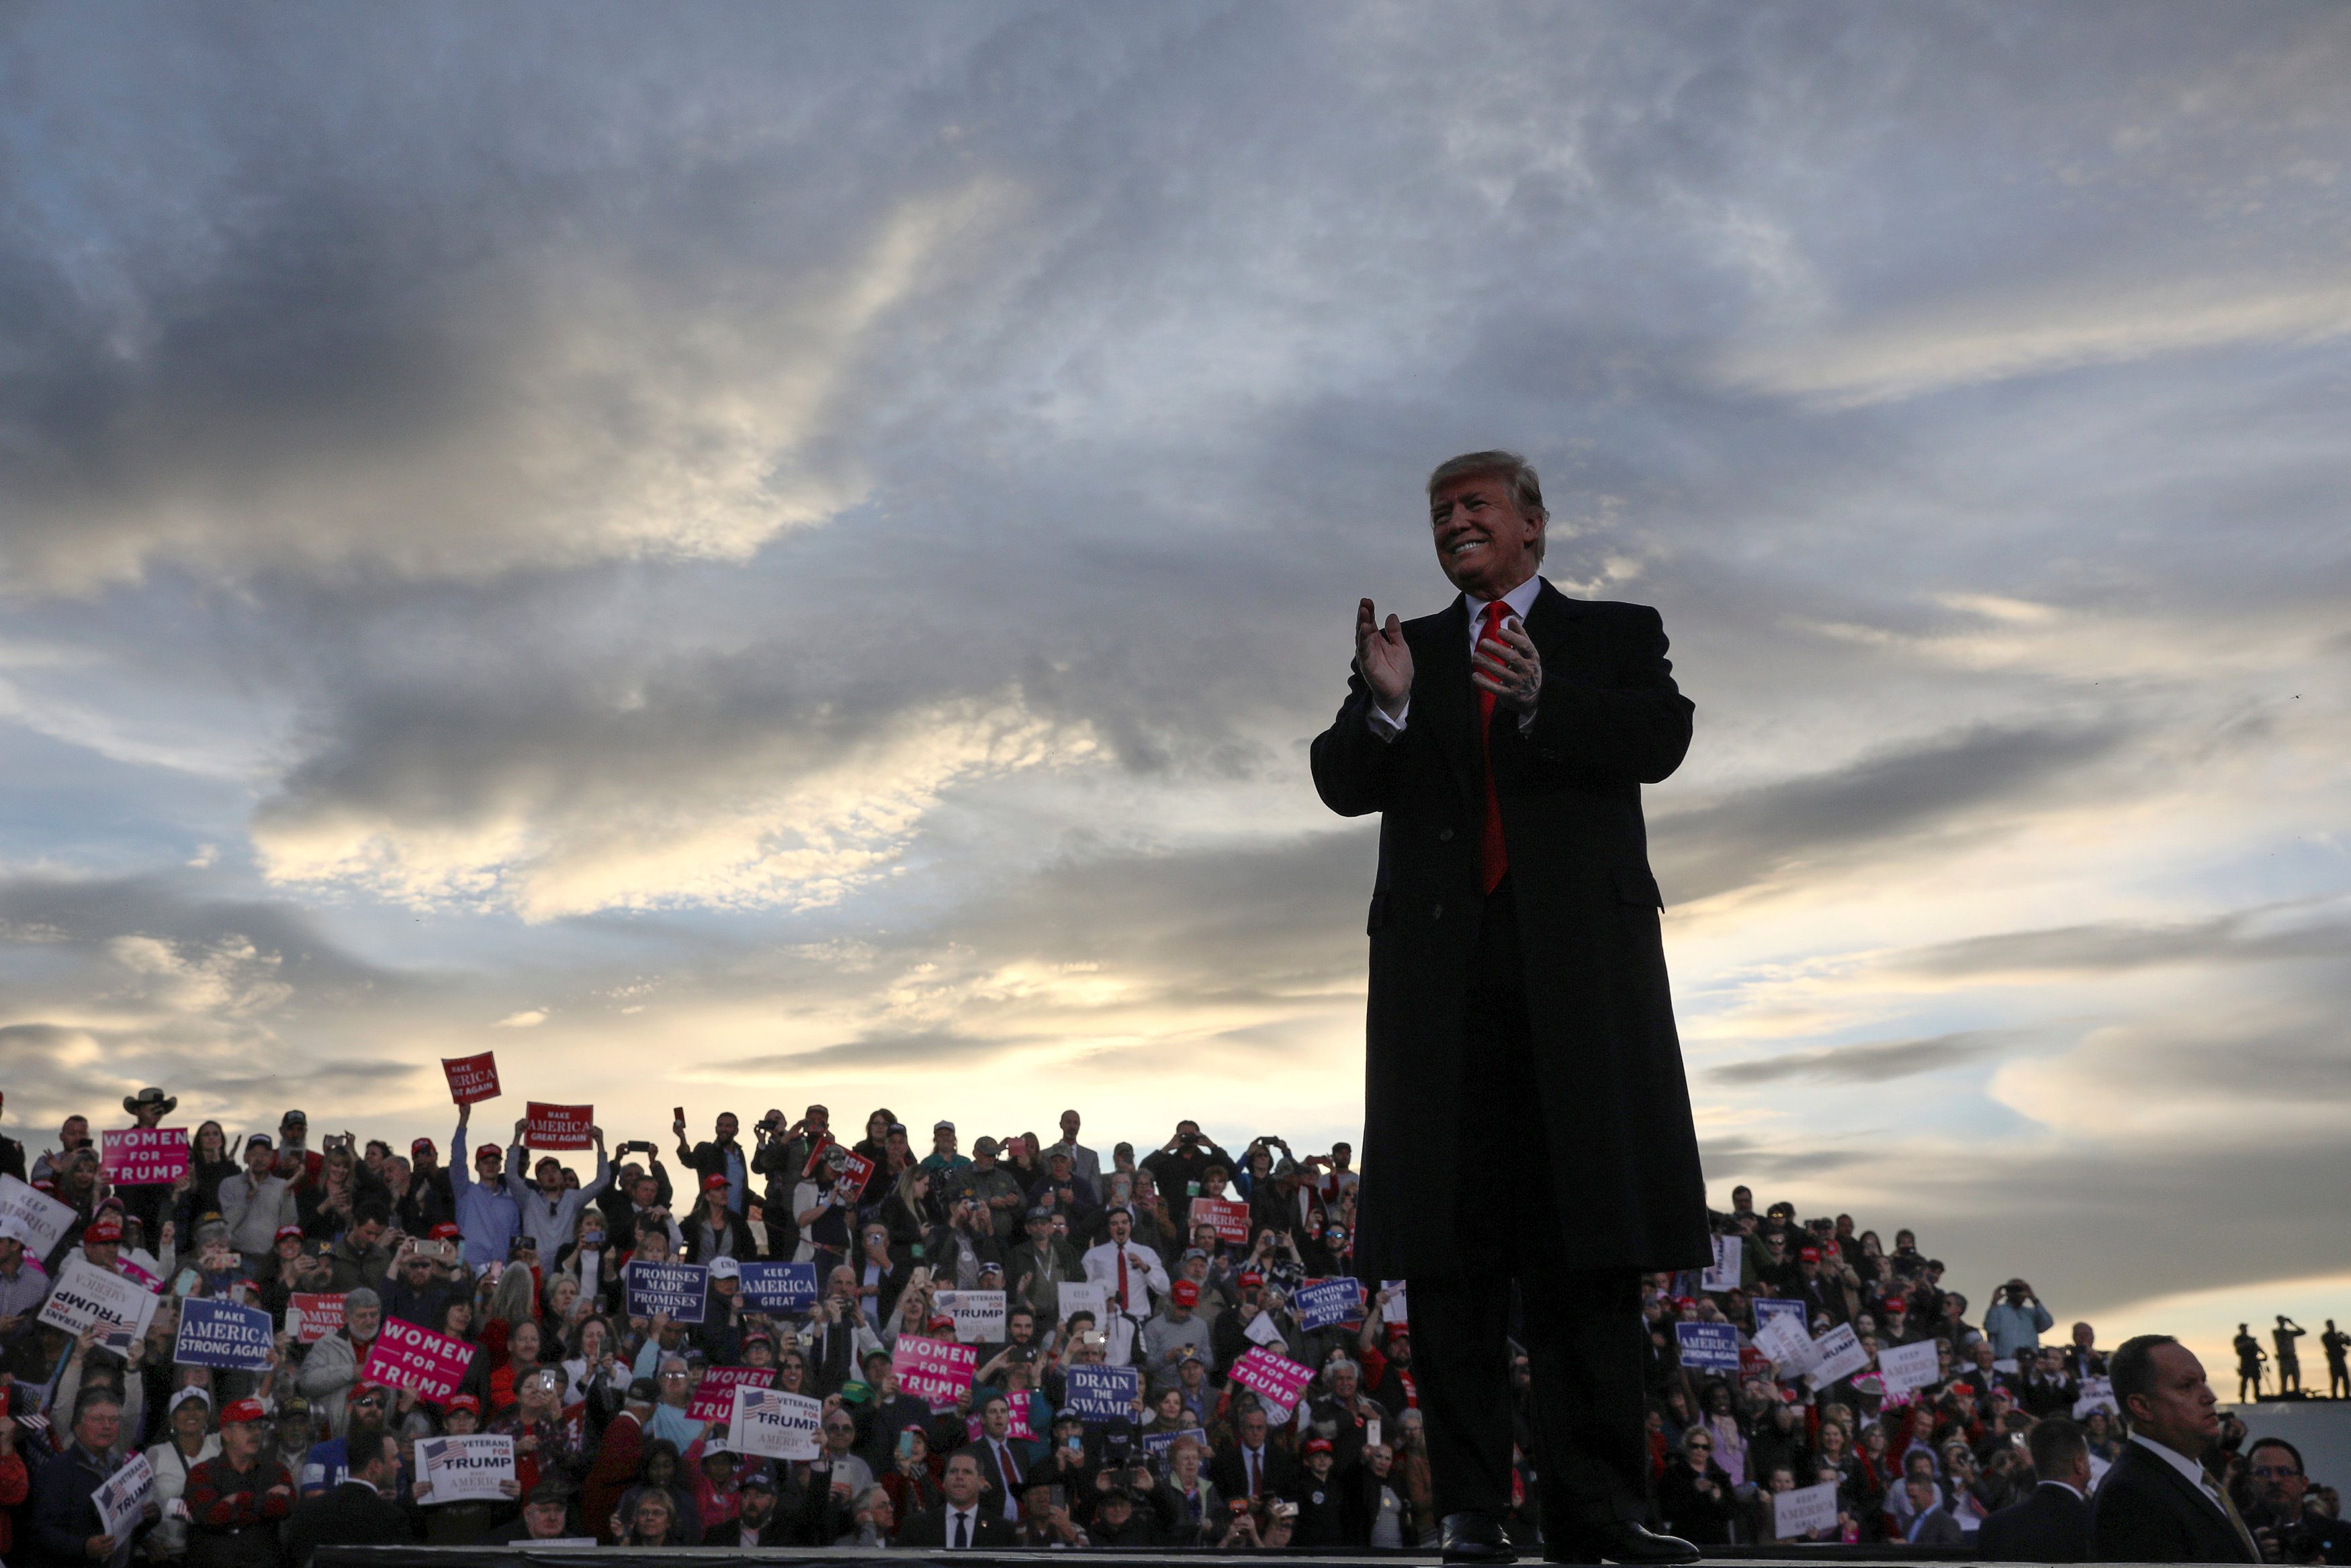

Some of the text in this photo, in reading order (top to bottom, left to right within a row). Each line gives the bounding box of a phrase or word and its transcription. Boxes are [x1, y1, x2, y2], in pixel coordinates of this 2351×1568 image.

[451, 1068, 494, 1086] ERICA
[465, 1082, 493, 1095] AGAIN
[547, 1111, 570, 1119] MAKE
[528, 1119, 590, 1132] AMERICA
[104, 1131, 187, 1147] WOMEN
[531, 1134, 586, 1142] GREAT AGAIN
[129, 1150, 160, 1162] FOR
[105, 1165, 183, 1180] TRUMP
[1197, 1213, 1240, 1227] MERIC
[635, 1267, 699, 1283] PROMISES
[763, 1268, 791, 1277] KEEP
[647, 1279, 684, 1292] MADE
[743, 1279, 815, 1293] AMERICA
[1302, 1282, 1353, 1302] PROMISES
[634, 1292, 697, 1307] PROMISES
[761, 1296, 795, 1307] GREAT
[1313, 1291, 1342, 1304] MADE
[55, 1292, 122, 1326] TRUMP
[214, 1309, 245, 1323] MAKE
[646, 1304, 679, 1317] KEPT
[952, 1309, 1004, 1318] TRUMP
[1305, 1301, 1356, 1318] PROMISES
[1318, 1311, 1345, 1322] KEPT
[44, 1308, 87, 1330] ETERANS
[300, 1310, 345, 1324] AMER
[181, 1320, 271, 1346] AMERICA
[1698, 1328, 1719, 1336] MAKE
[179, 1338, 230, 1355] STRONG
[384, 1320, 474, 1365] WOMEN
[1681, 1337, 1737, 1351] AMERICA
[1823, 1338, 1855, 1360] RUMP
[900, 1338, 976, 1365] WOMEN
[402, 1351, 436, 1373] FOR
[919, 1361, 948, 1375] FOR
[1251, 1347, 1315, 1381] WOMEN
[371, 1359, 451, 1398] TRUMP
[705, 1369, 774, 1387] WOMEN
[1259, 1365, 1284, 1380] FOR
[895, 1372, 966, 1397] TRUMP
[1075, 1373, 1129, 1390] DRAIN
[1237, 1365, 1294, 1401] TRUMP
[718, 1388, 734, 1399] FO
[1093, 1388, 1113, 1399] THE
[693, 1401, 729, 1418] TRU
[777, 1396, 819, 1412] VETERANS
[1071, 1397, 1133, 1416] SWAMP
[758, 1412, 819, 1430] TRUMP
[803, 1410, 818, 1418] FOR
[461, 1439, 510, 1448] VETERANS
[715, 1440, 727, 1448] US
[443, 1457, 512, 1470] TRUMP
[451, 1477, 497, 1487] AMERIC
[117, 1477, 153, 1516] TRUMP
